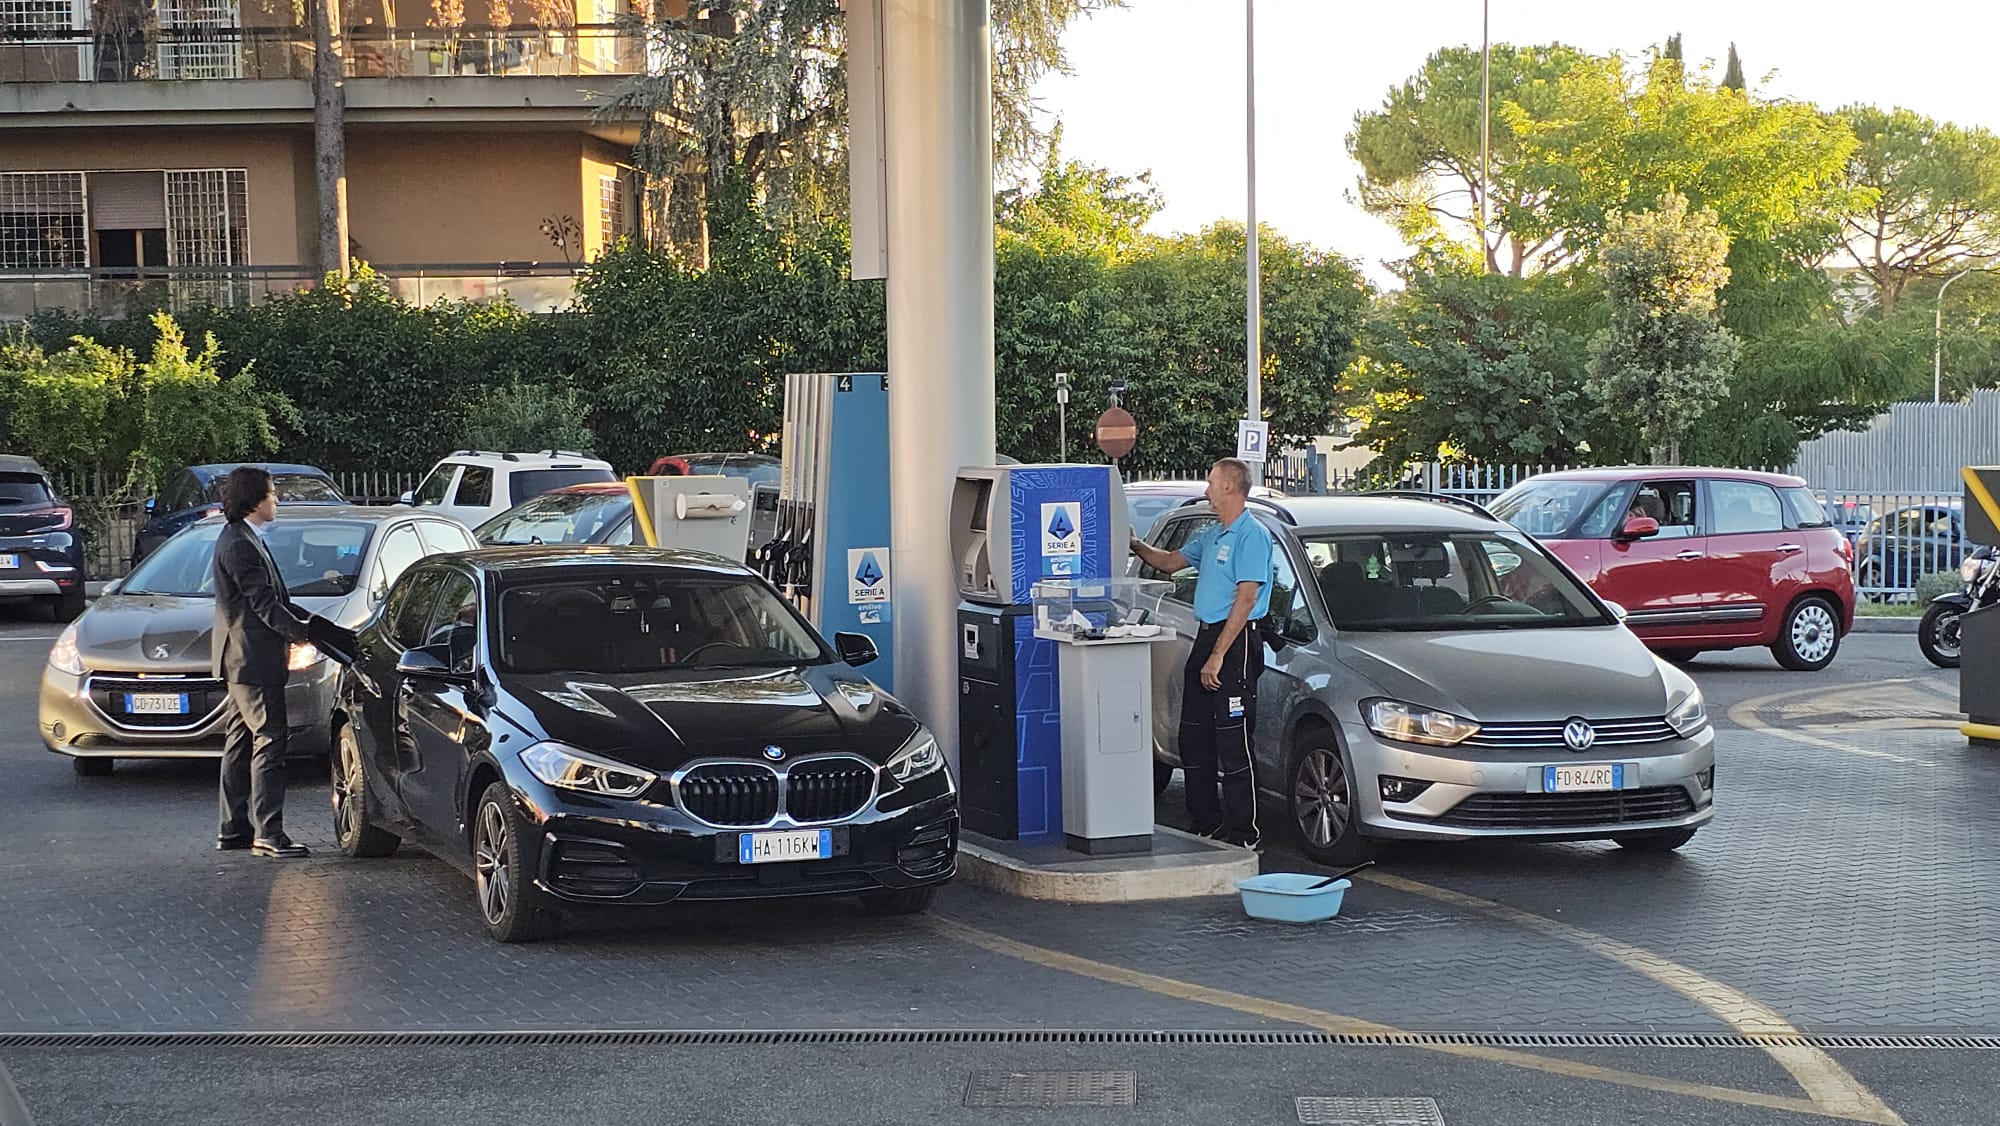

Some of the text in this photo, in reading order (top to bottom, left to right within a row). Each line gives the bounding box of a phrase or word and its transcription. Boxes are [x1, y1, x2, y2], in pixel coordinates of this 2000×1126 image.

[840, 376, 851, 391] 4
[1246, 432, 1259, 450] P
[1047, 542, 1069, 550] SERIE
[854, 587, 885, 597] SERIE A
[754, 840, 771, 857] HA
[777, 836, 819, 855] 116KW
